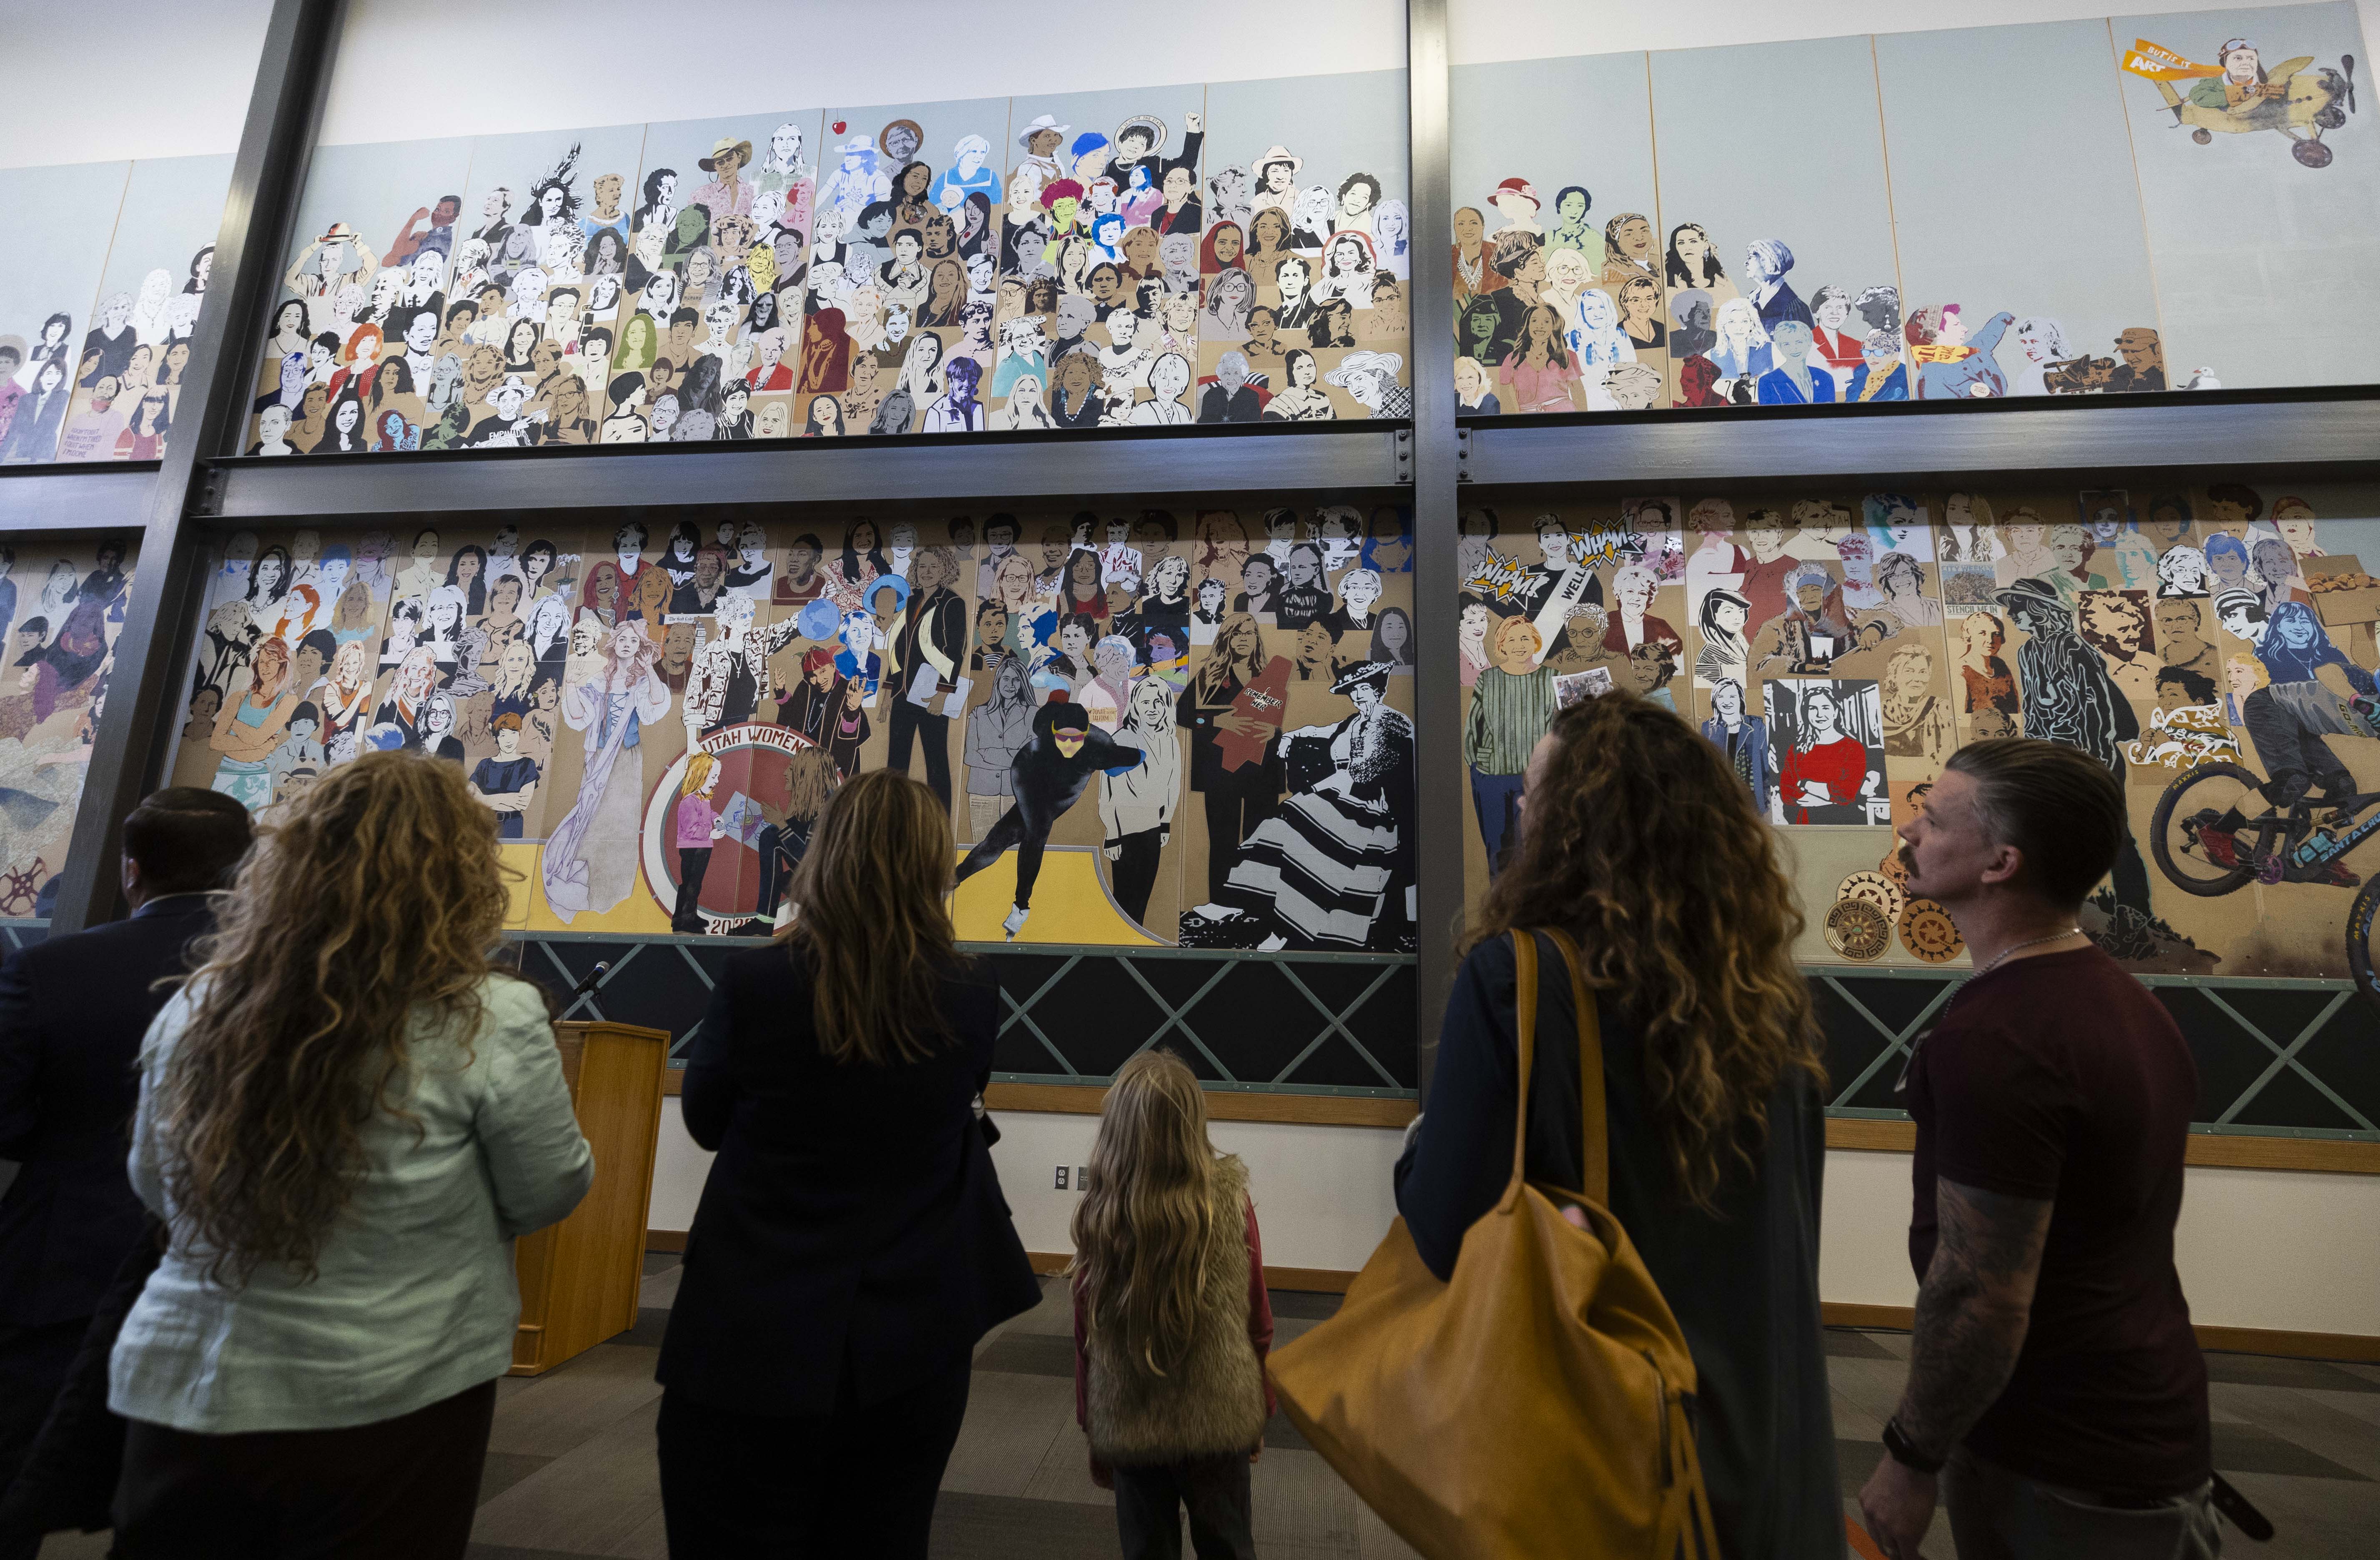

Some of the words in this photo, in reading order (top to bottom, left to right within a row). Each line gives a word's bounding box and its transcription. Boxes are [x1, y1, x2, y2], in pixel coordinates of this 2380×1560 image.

[2129, 56, 2166, 72] ART
[2147, 46, 2168, 58] BUT
[1571, 514, 1634, 561] WHAM!
[1474, 561, 1546, 597] WHAM!
[1244, 688, 1283, 708] REMEMBER
[1251, 700, 1267, 711] HER
[702, 730, 741, 754] UTAH
[747, 728, 805, 755] WOMEN
[2172, 769, 2199, 790] MAXXIS
[2320, 830, 2362, 862] SANTA
[2354, 895, 2371, 941] MAXXIS
